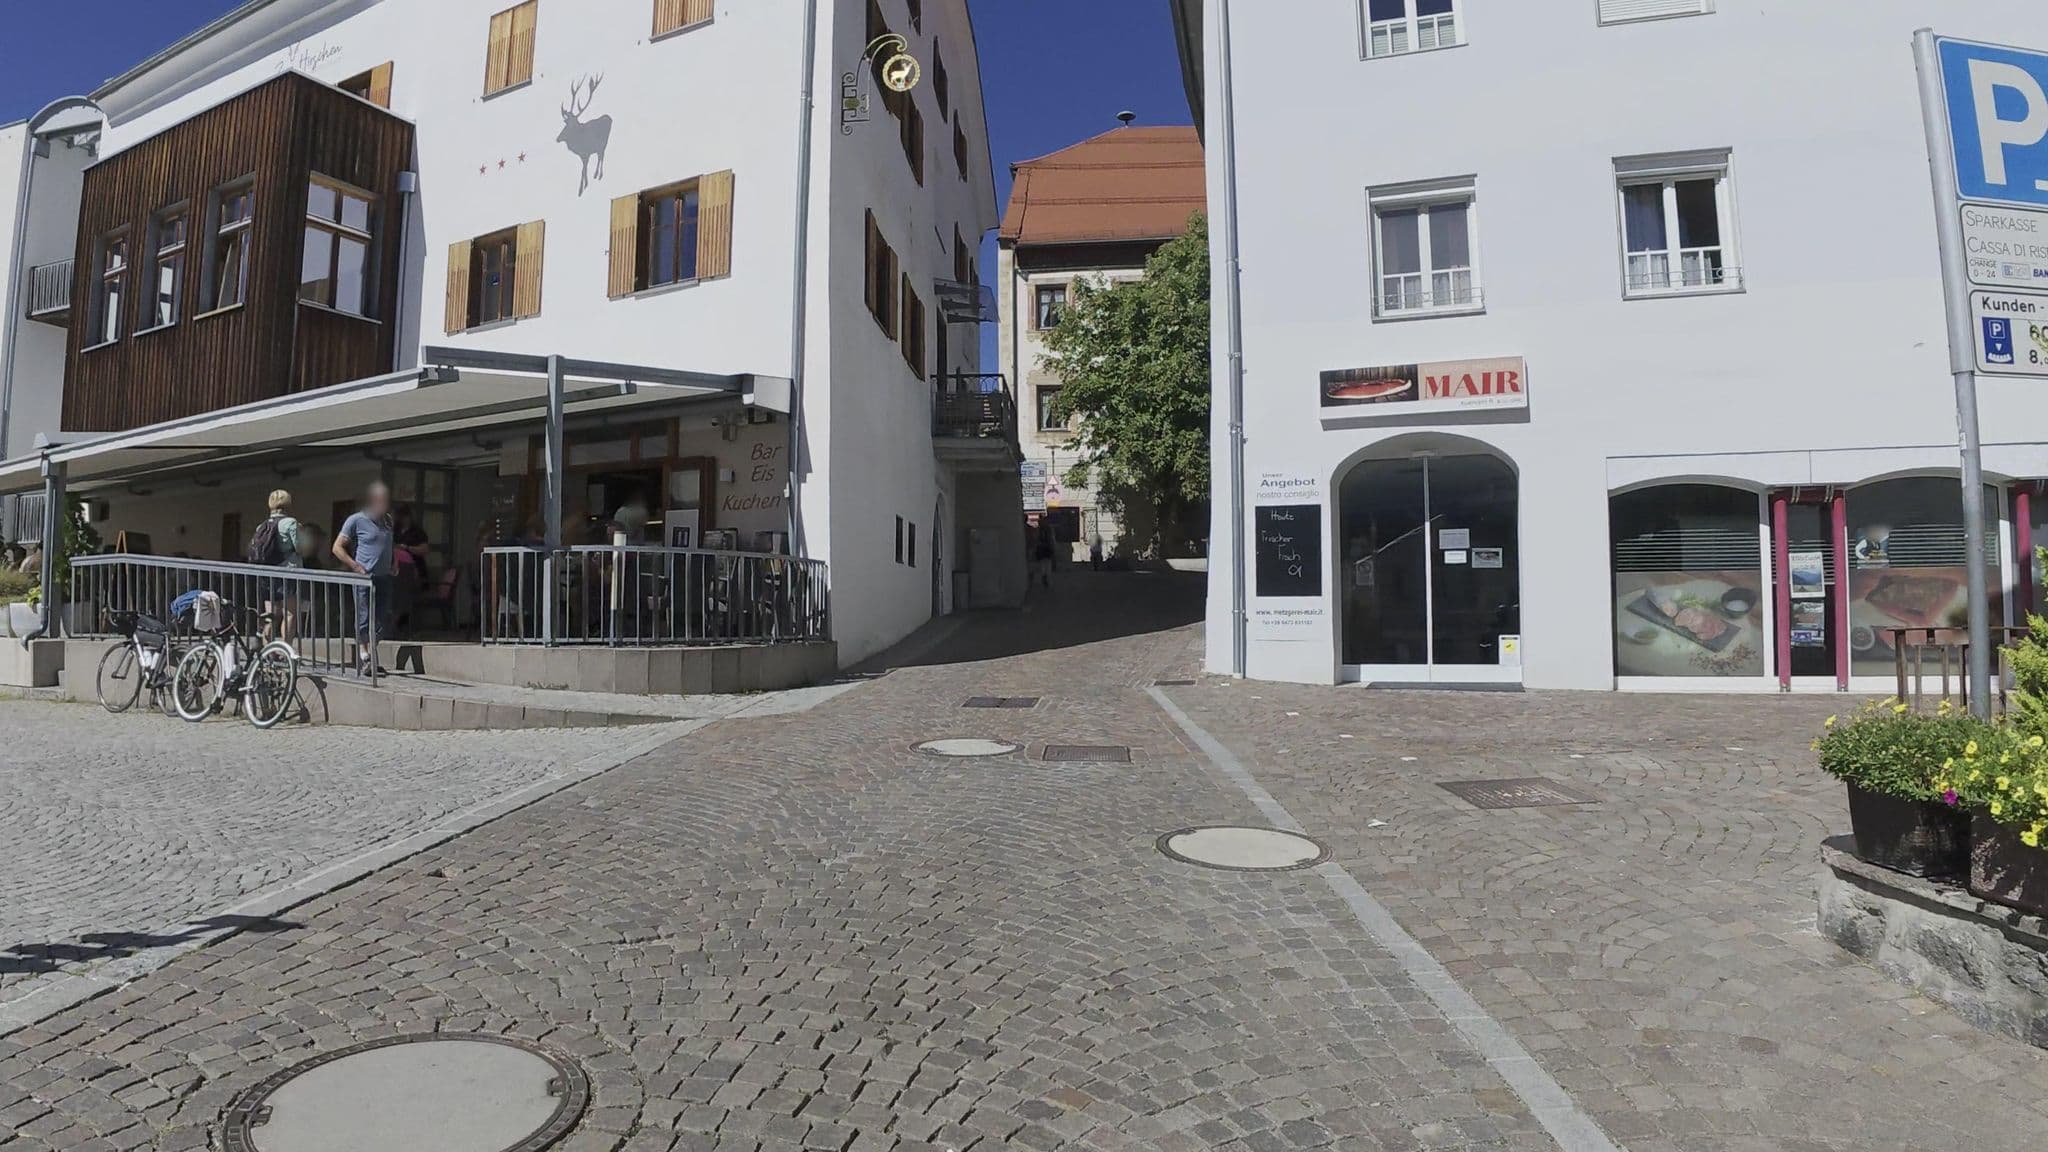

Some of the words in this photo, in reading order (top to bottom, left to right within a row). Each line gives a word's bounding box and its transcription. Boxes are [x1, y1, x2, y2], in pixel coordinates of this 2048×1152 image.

[1968, 58, 2048, 186] P
[1966, 210, 2038, 233] SPARKASSE
[1967, 236, 2011, 255] CASSA
[2014, 243, 2026, 257] DI
[1982, 296, 2036, 313] Kunden
[1425, 371, 1520, 399] MAIR
[751, 442, 783, 461] Bar
[751, 464, 776, 482] Eis
[1260, 478, 1316, 488] Angebot
[722, 494, 781, 511] Kuchen
[1284, 489, 1320, 499] consiglio
